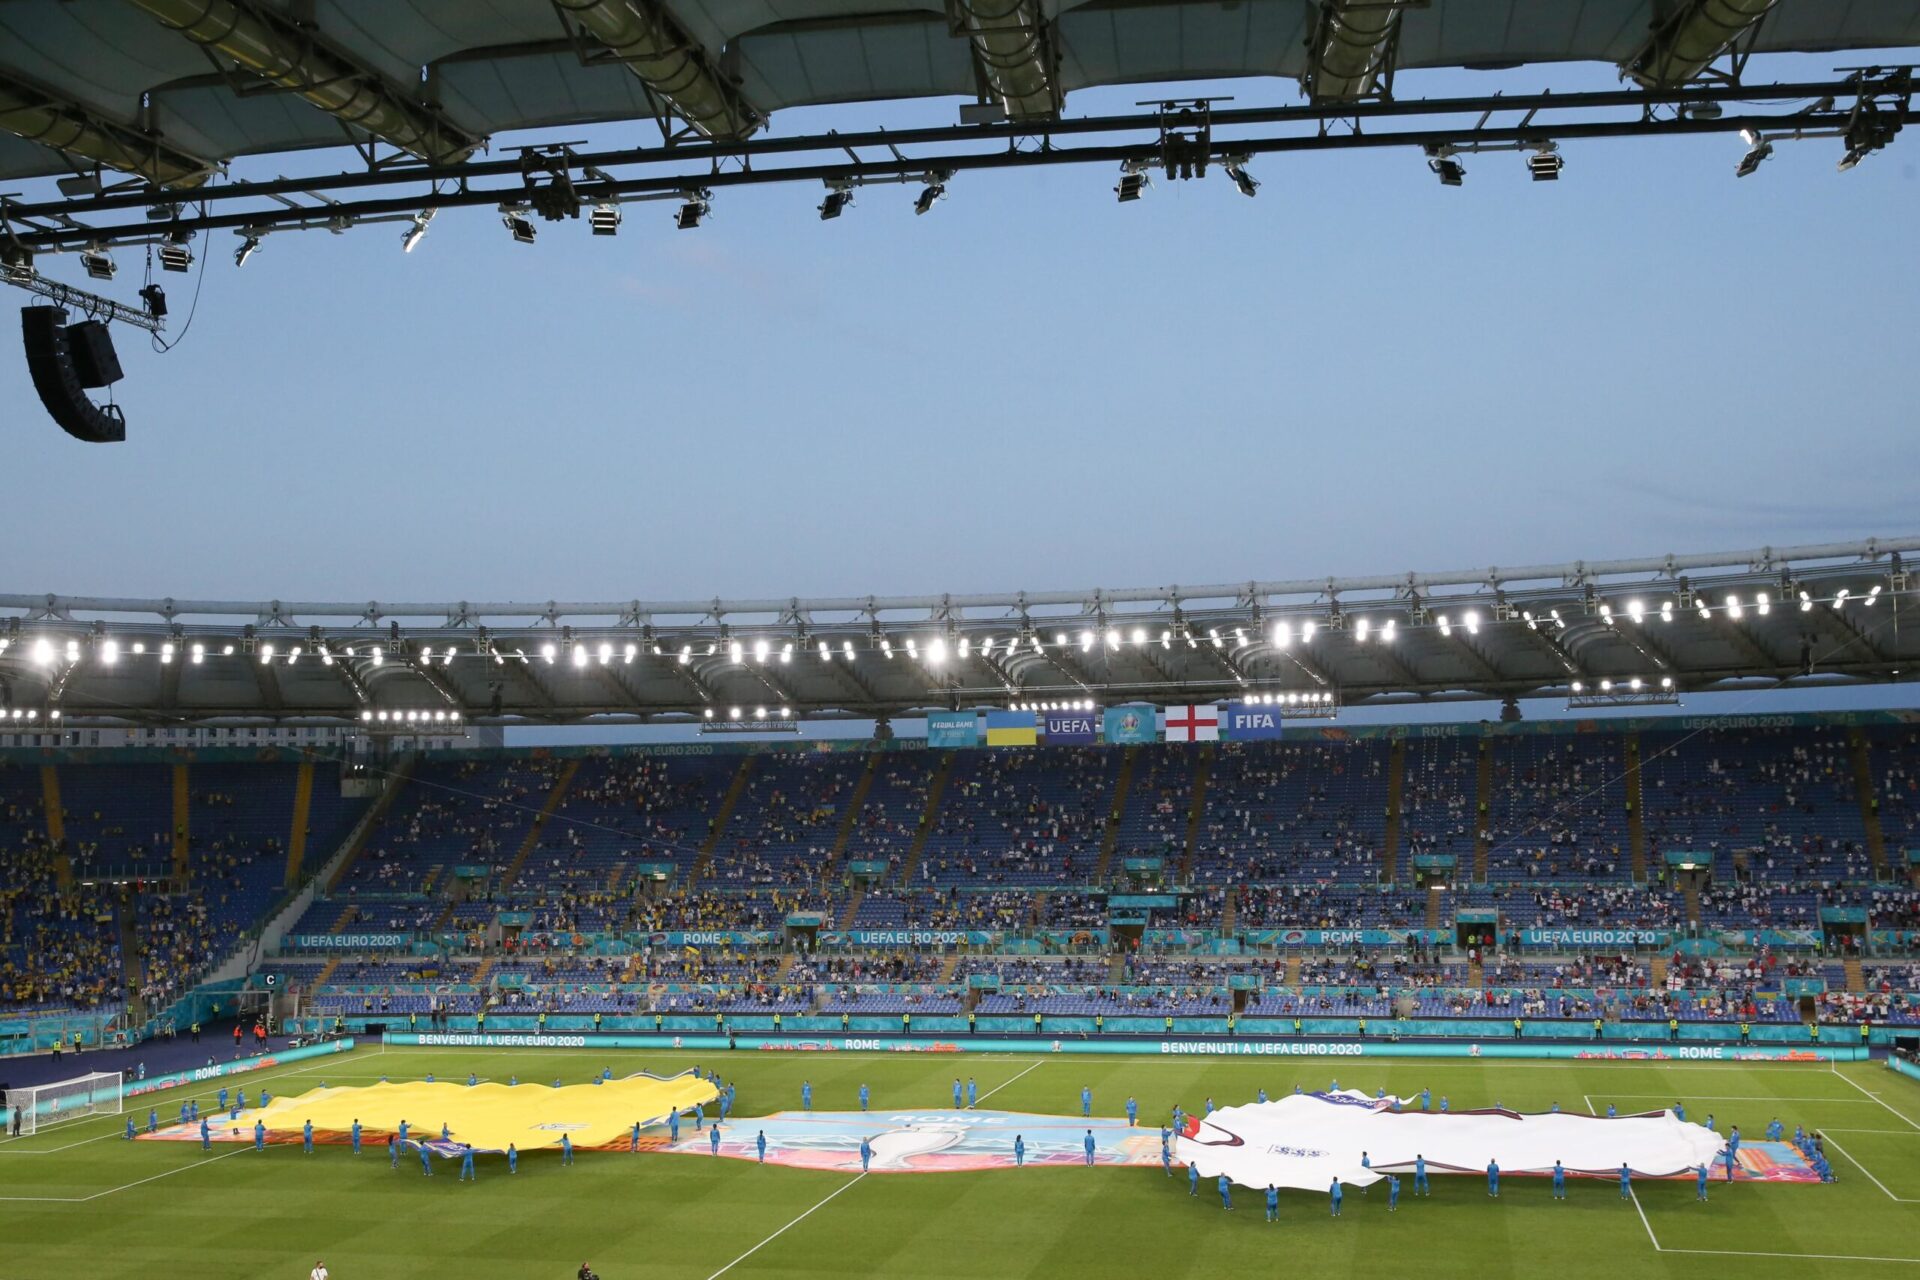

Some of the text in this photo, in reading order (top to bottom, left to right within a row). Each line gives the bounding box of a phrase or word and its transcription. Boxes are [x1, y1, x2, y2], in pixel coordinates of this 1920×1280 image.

[1050, 720, 1091, 733] UEFA
[1235, 714, 1275, 728] FIFA
[1718, 717, 1758, 728] EURO
[1759, 716, 1794, 727] 2020
[654, 746, 684, 756] EURO
[685, 745, 713, 755] 2020
[900, 740, 928, 751] ROM
[301, 935, 401, 947] UEFA EURO 2020
[683, 933, 720, 944] ROME
[860, 932, 895, 943] UEFA
[896, 932, 931, 943] EURO
[1530, 931, 1656, 943] UEFA EURO 2020
[266, 975, 275, 985] C
[418, 1034, 585, 1046] BENVENUTI A UEFA EURO 2020
[845, 1039, 880, 1050] ROME
[1161, 1042, 1363, 1055] BENVENUTI A UEFA EURO 2020
[1679, 1047, 1722, 1059] ROME
[195, 1064, 222, 1080] ROME
[888, 1115, 1009, 1123] ROME
